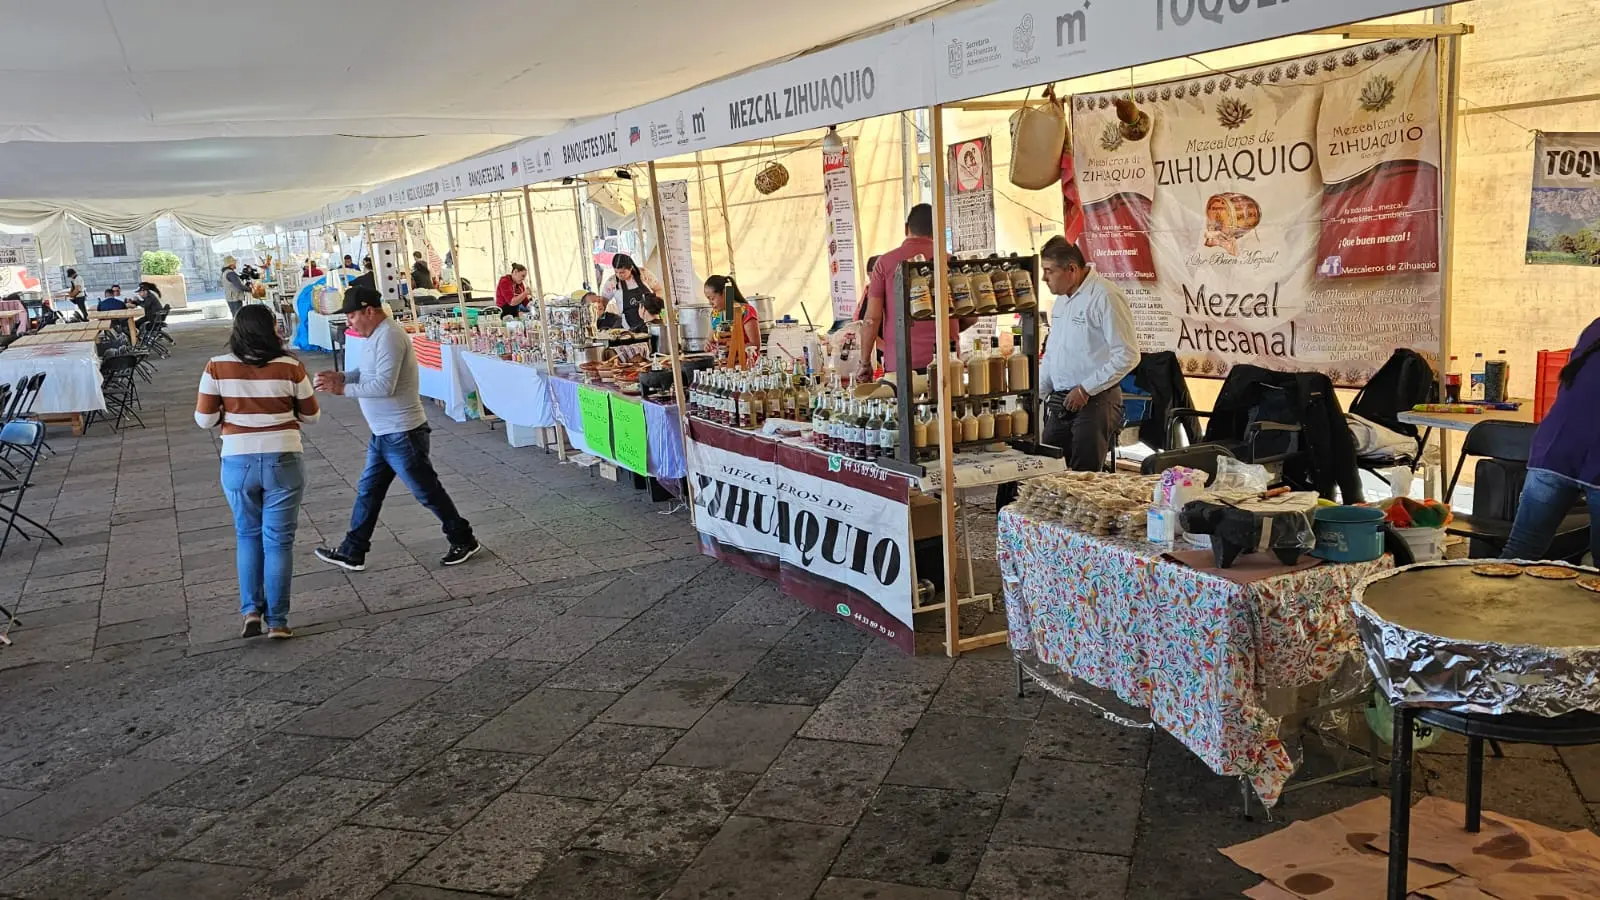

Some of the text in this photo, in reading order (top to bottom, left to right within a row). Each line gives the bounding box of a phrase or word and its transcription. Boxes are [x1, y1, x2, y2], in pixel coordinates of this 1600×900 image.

[729, 66, 875, 130] MEZCAL ZIHUAQUIO
[1399, 112, 1415, 124] de
[562, 137, 600, 164] BANQUETES
[600, 131, 618, 155] DIAZ
[1186, 129, 1275, 153] Mezcaleros de
[1329, 126, 1423, 156] ZIHUAQUIO
[1155, 141, 1315, 186] ZIHUAQUIO
[1356, 236, 1376, 246] buen
[1377, 232, 1406, 245] mezcal
[1208, 251, 1238, 266] Buen
[1341, 260, 1437, 275] Mezcaleros de Zihuaquio
[1182, 282, 1279, 318] Mezcal
[1177, 318, 1296, 357] Artesanal
[720, 464, 854, 514] MEZCAEROS DE
